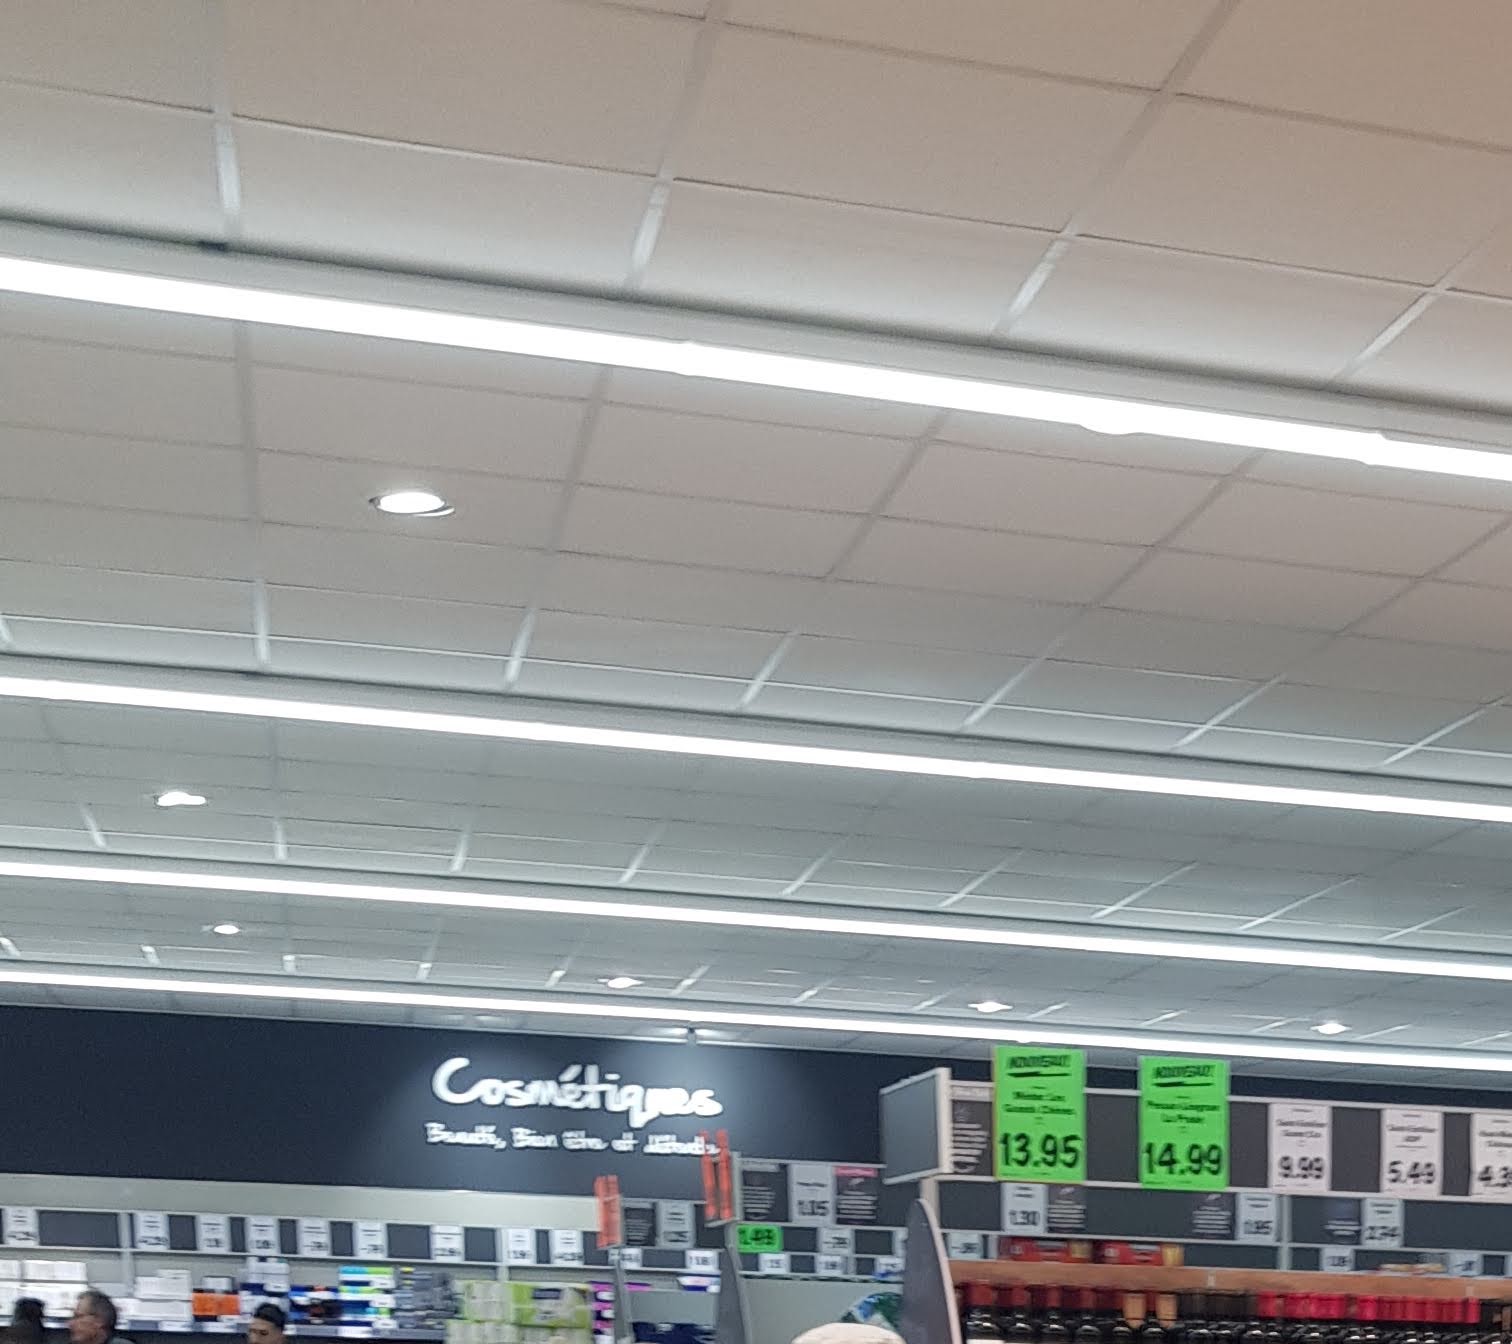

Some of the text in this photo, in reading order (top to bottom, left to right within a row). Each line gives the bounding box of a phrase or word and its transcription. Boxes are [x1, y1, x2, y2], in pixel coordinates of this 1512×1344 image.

[431, 1056, 724, 1128] Cosmétiques
[612, 1131, 639, 1151] et
[1000, 1132, 1083, 1168] 13.95
[1144, 1142, 1223, 1176] 14.99
[1387, 1160, 1437, 1186] 5.49
